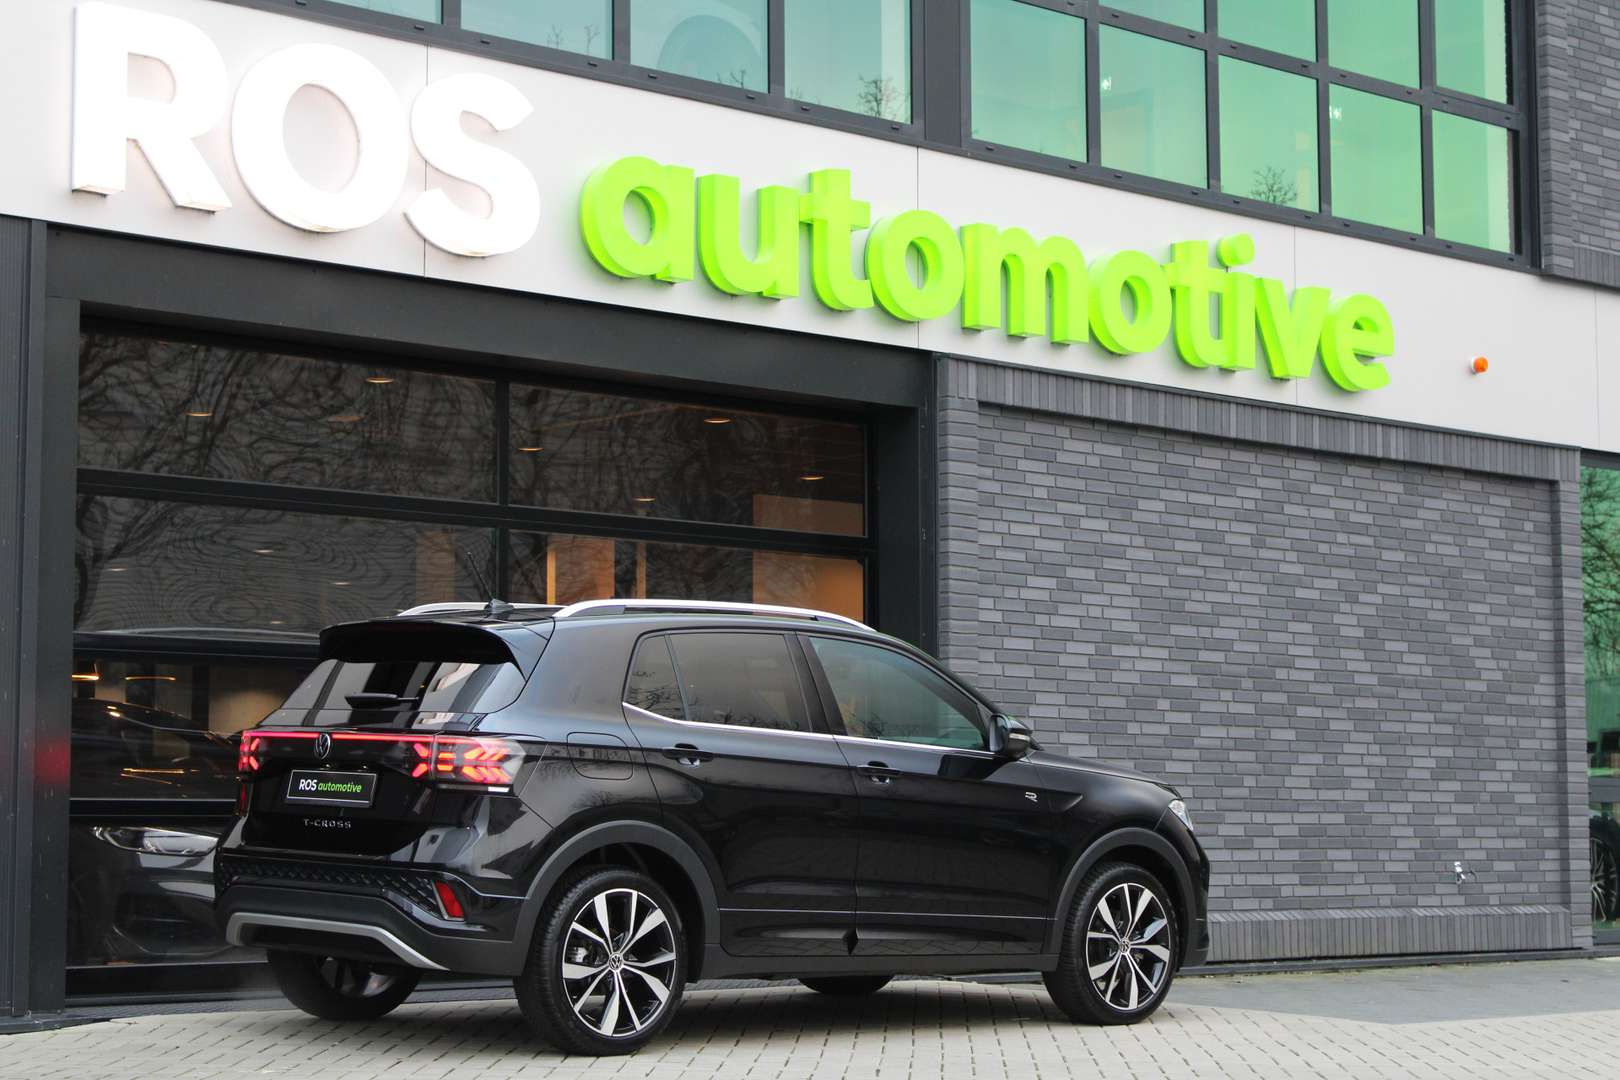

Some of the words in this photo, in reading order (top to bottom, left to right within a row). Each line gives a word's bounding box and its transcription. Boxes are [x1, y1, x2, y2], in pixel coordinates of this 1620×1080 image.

[72, 2, 541, 258] ROS
[580, 155, 1395, 394] automotive
[299, 778, 318, 792] ROS
[318, 781, 362, 793] automotive
[303, 818, 352, 829] T-CROSS
